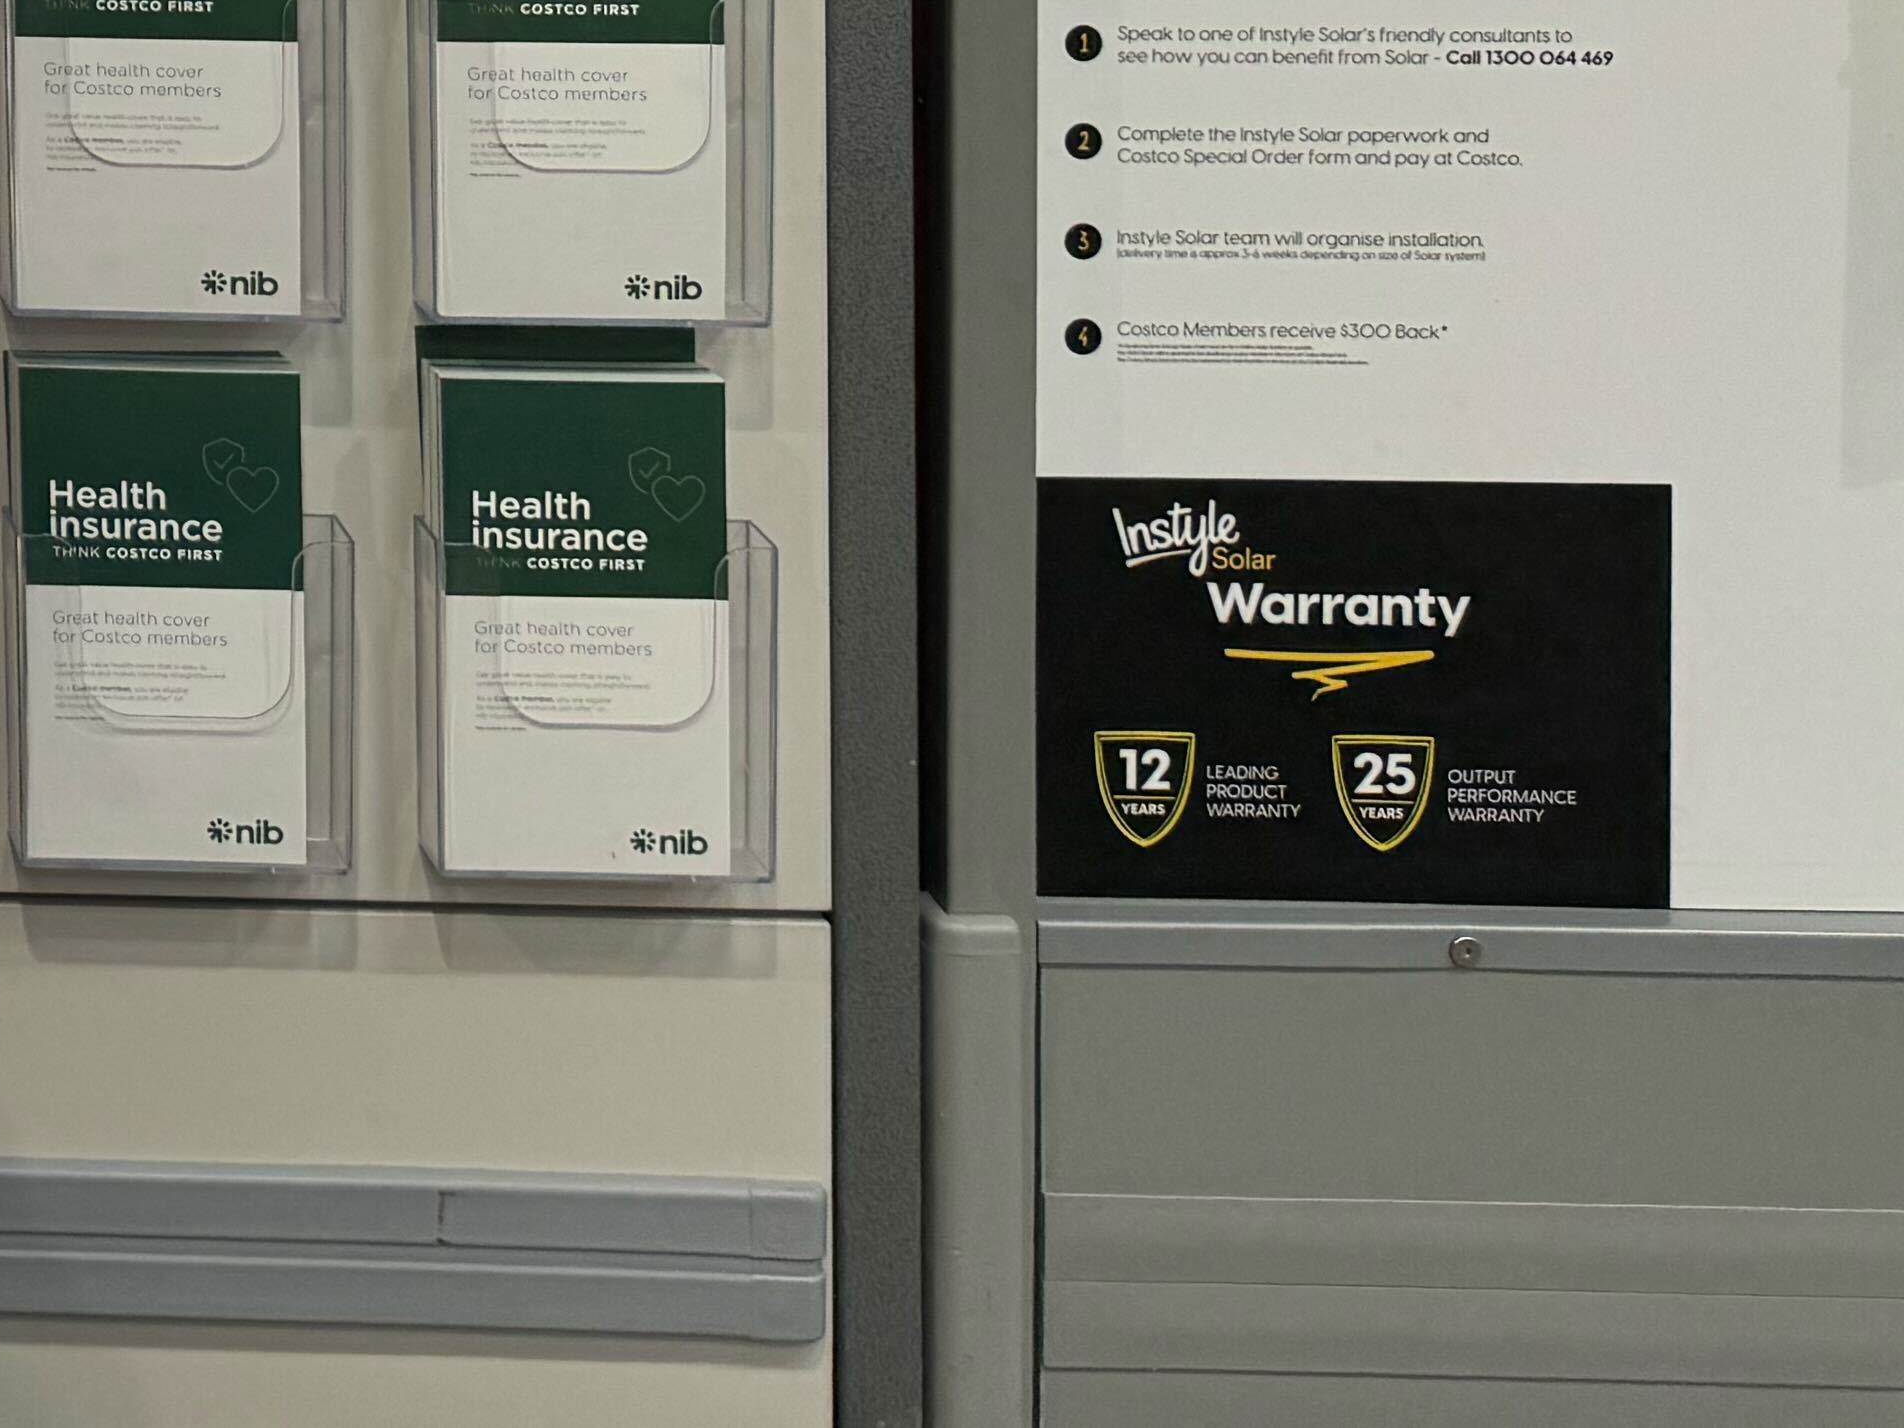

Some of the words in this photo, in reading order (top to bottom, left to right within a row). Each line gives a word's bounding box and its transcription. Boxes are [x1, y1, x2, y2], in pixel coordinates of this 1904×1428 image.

[168, 0, 213, 14] FIRST
[44, 62, 92, 78] Great
[97, 63, 151, 78] health
[156, 66, 203, 79] cover
[44, 80, 67, 95] for
[74, 81, 134, 97] Costco
[140, 83, 221, 99] members
[230, 270, 279, 296] nib
[1117, 322, 1178, 340] Costco
[1184, 322, 1266, 340] Members
[1271, 322, 1334, 339] receive
[1339, 322, 1390, 341] $300
[1112, 499, 1240, 576] Instyle
[1212, 548, 1275, 570] Solar
[1206, 581, 1470, 637] Warranty
[1118, 748, 1171, 791] 12
[1206, 765, 1279, 780] LEADING
[1353, 751, 1417, 795] 25
[1448, 769, 1516, 785] OUTPUT
[1207, 784, 1287, 799] PRODUCT
[1448, 788, 1576, 805] PERFORMANCE
[1121, 802, 1166, 816] YEARS
[1206, 803, 1301, 819] WARRANTY
[1359, 806, 1403, 820] YEARS
[1448, 807, 1544, 824] WARRANTY
